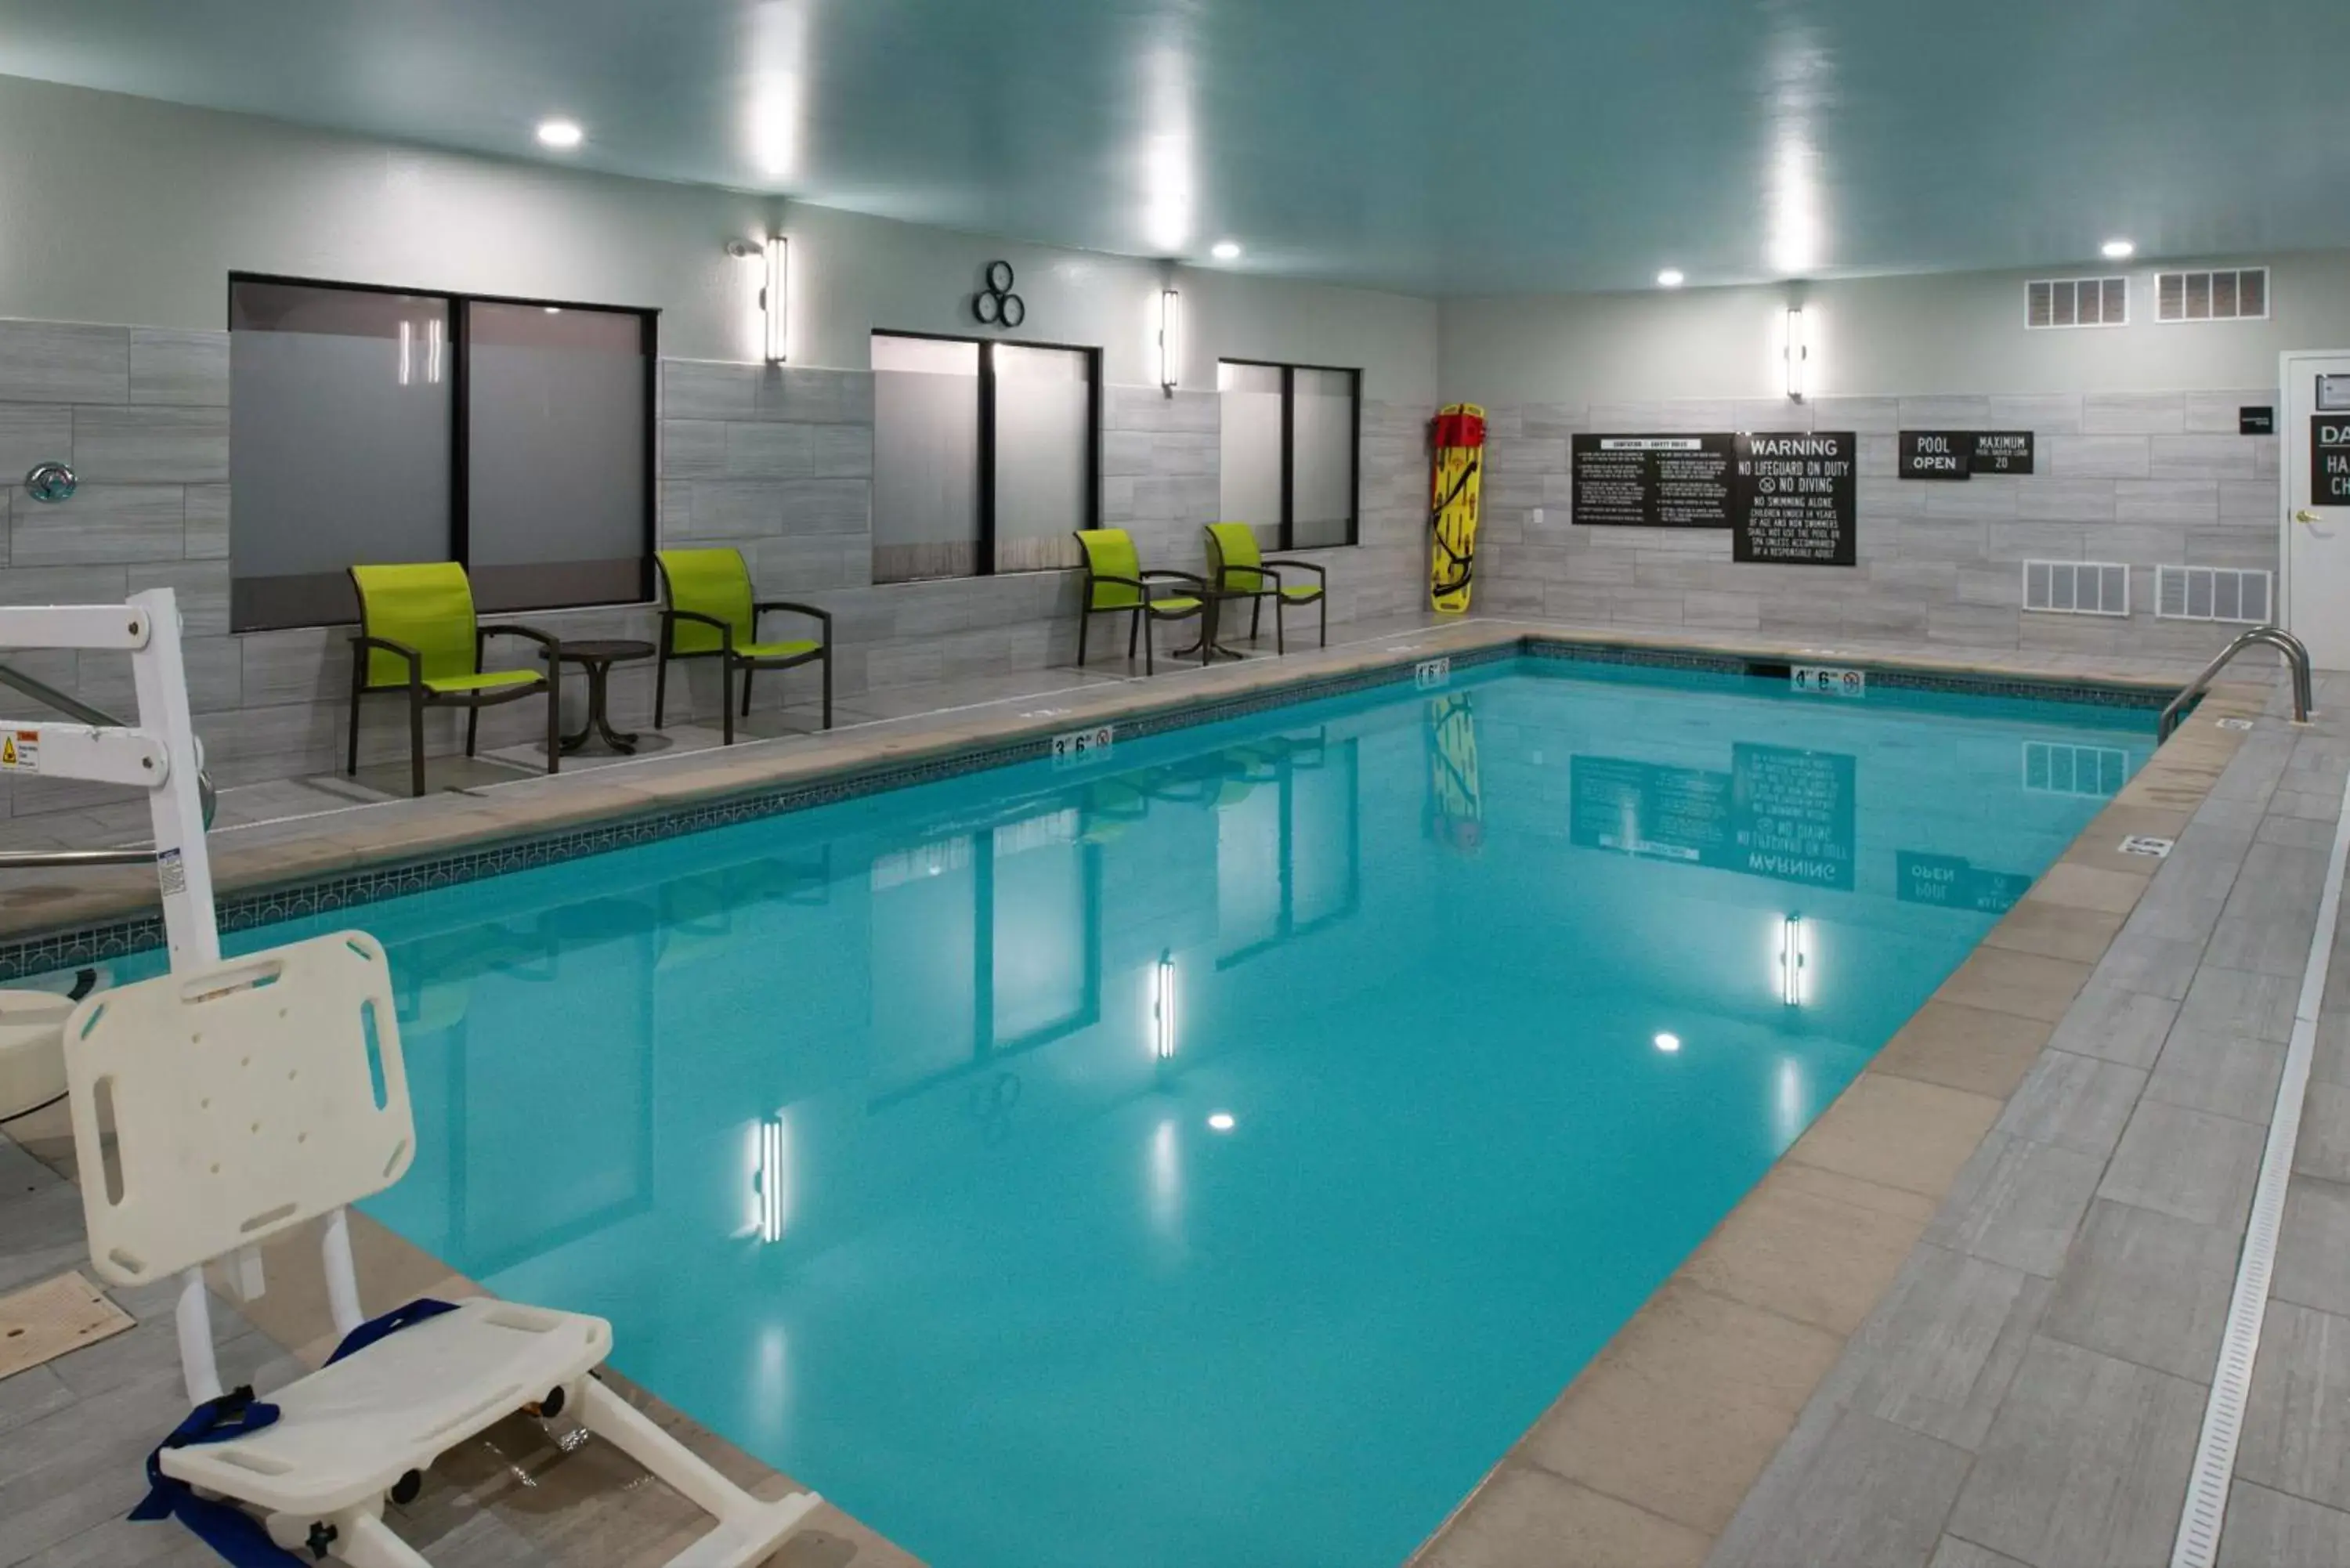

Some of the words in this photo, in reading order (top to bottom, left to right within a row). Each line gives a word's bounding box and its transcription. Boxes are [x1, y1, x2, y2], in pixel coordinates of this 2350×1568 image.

[1751, 439, 1838, 456] WARNING
[1918, 437, 1950, 453] POOL
[1979, 436, 2025, 449] MAXIMUM
[1738, 461, 1751, 476] NO
[1755, 461, 1803, 476] LIFEGUARD
[1807, 461, 1820, 476] ON
[1824, 461, 1849, 476] DUTY
[1913, 457, 1956, 469] OPEN
[1995, 457, 2008, 468] 20
[1779, 478, 1793, 492] NO
[1799, 478, 1833, 493] DIVING
[1754, 497, 1765, 506] NO
[1808, 497, 1833, 508] ALONE
[1076, 735, 1086, 753] 6
